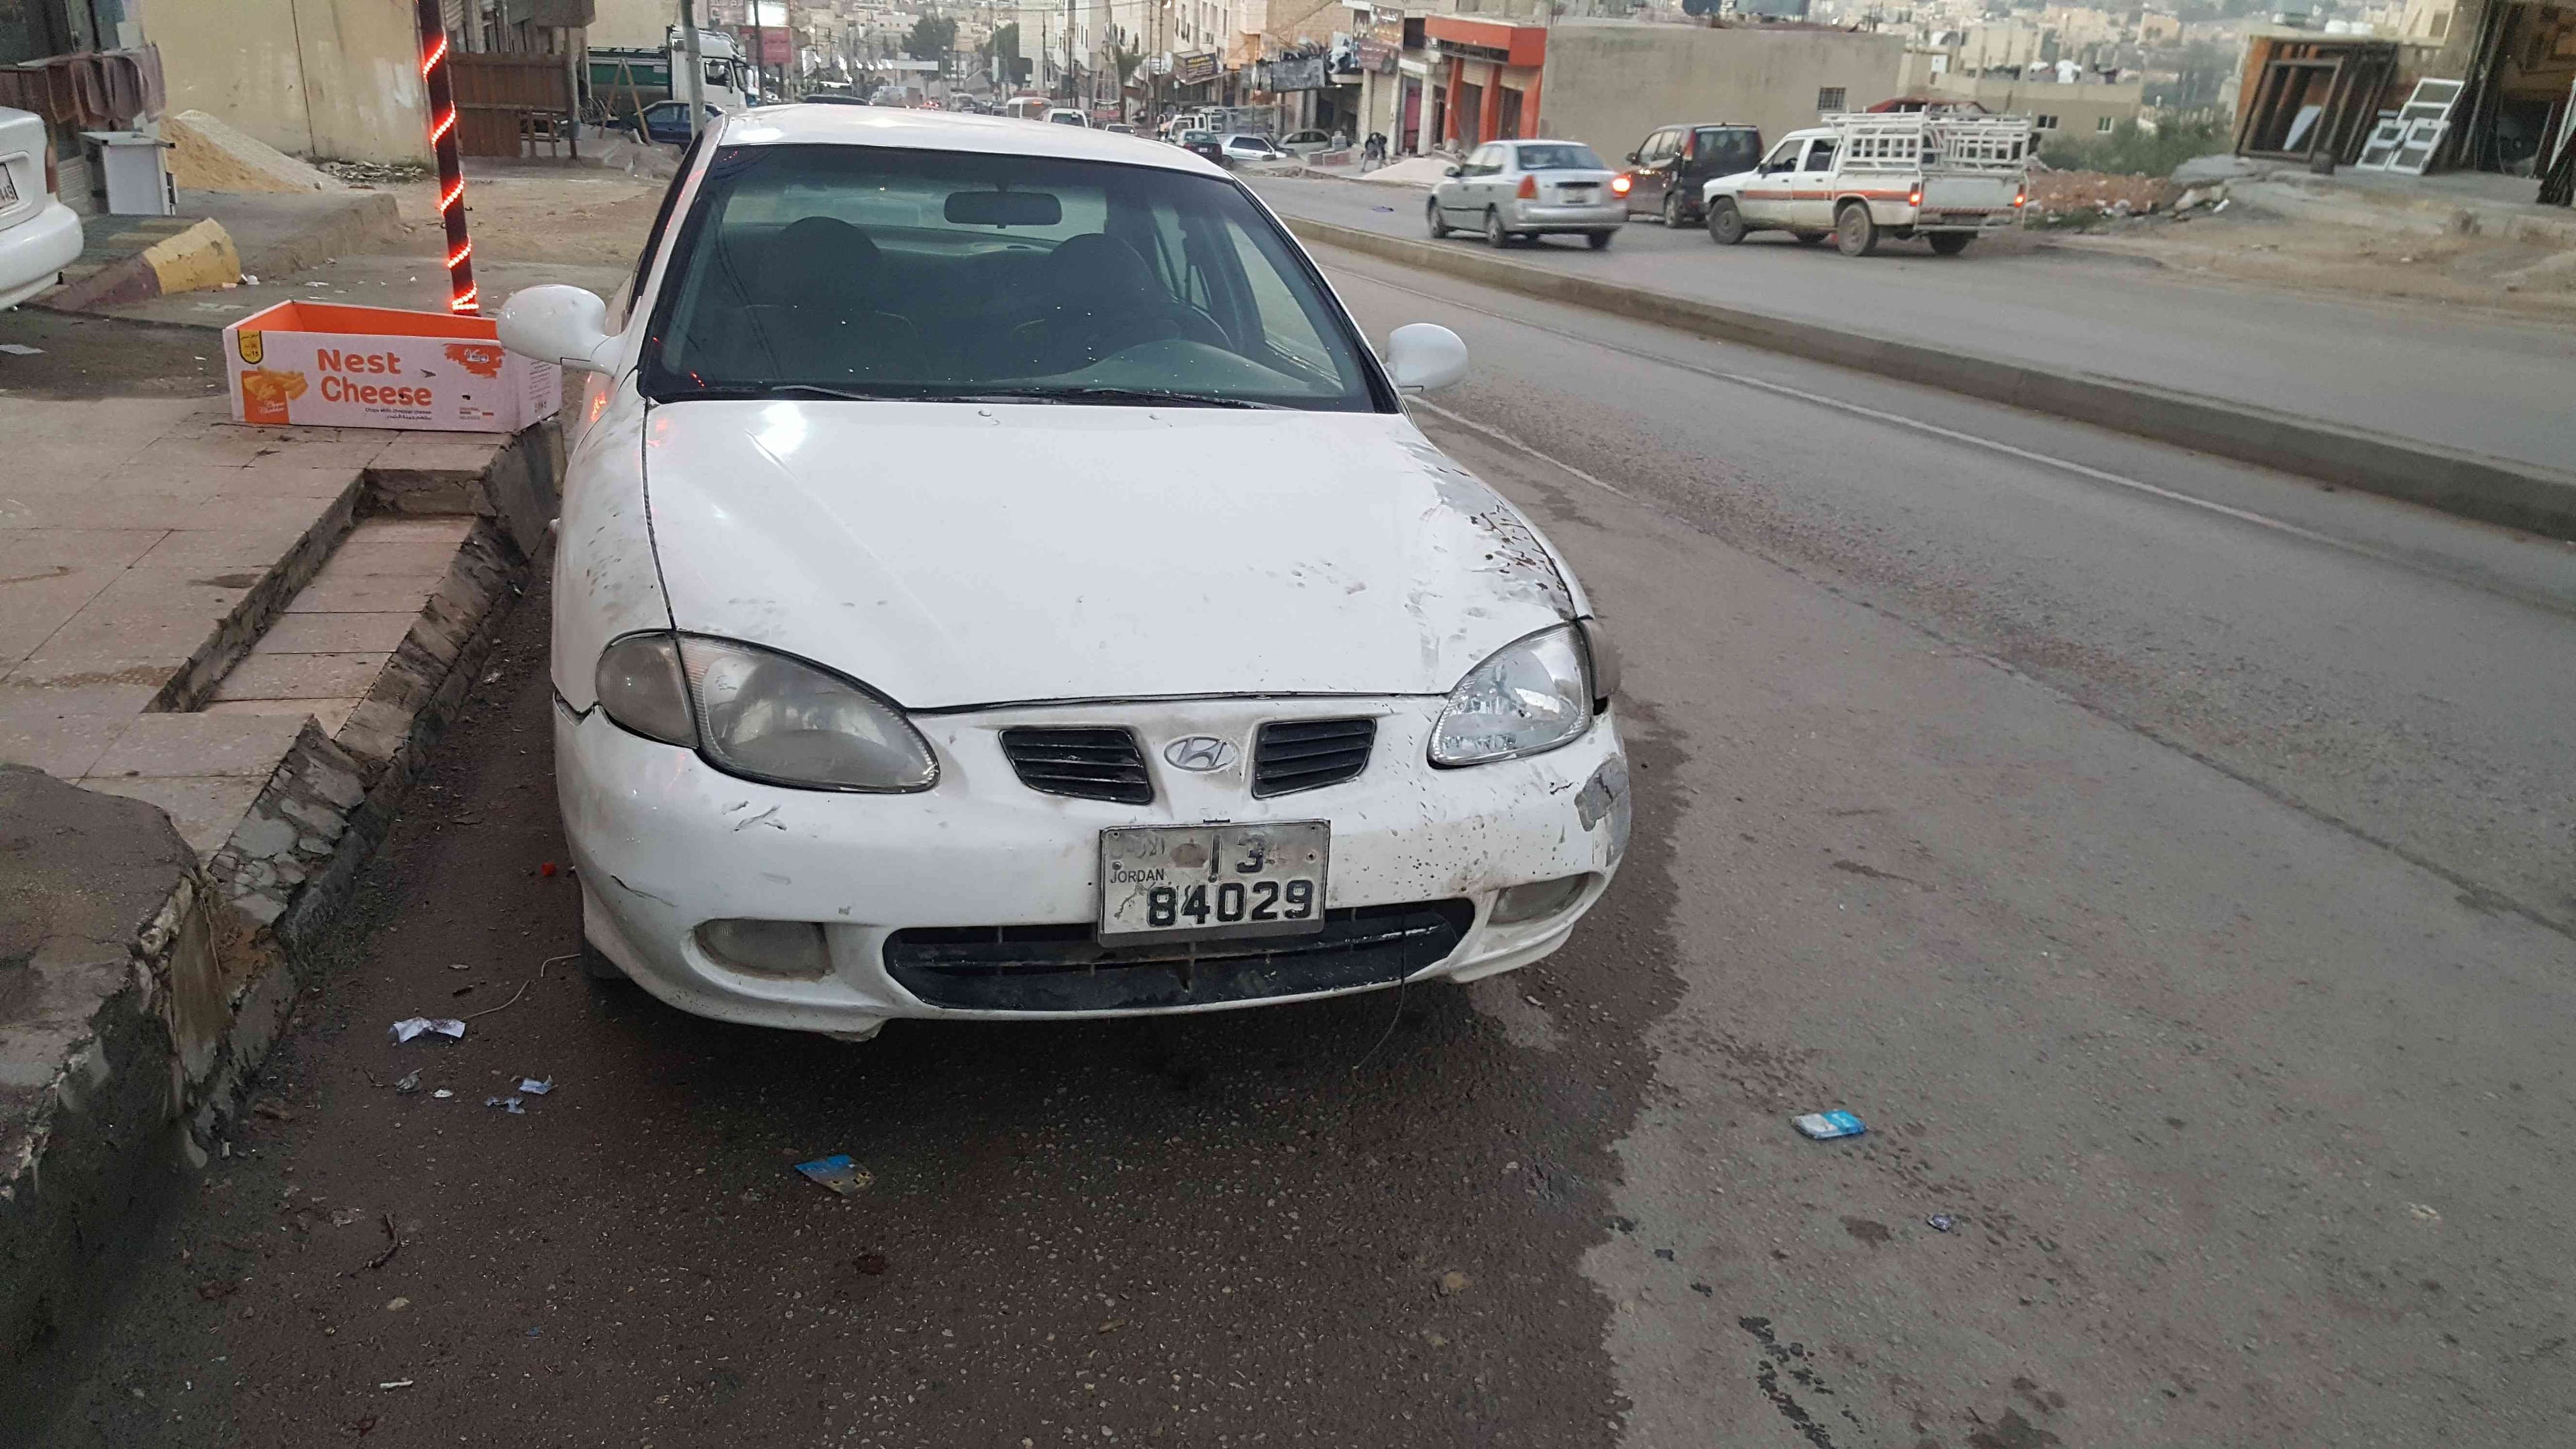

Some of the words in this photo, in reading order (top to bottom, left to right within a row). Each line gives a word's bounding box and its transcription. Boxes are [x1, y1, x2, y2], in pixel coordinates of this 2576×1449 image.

[317, 348, 401, 374] Nest
[321, 376, 432, 406] Cheese
[1110, 868, 1165, 884] JORDAN
[1148, 879, 1313, 927] 84029
